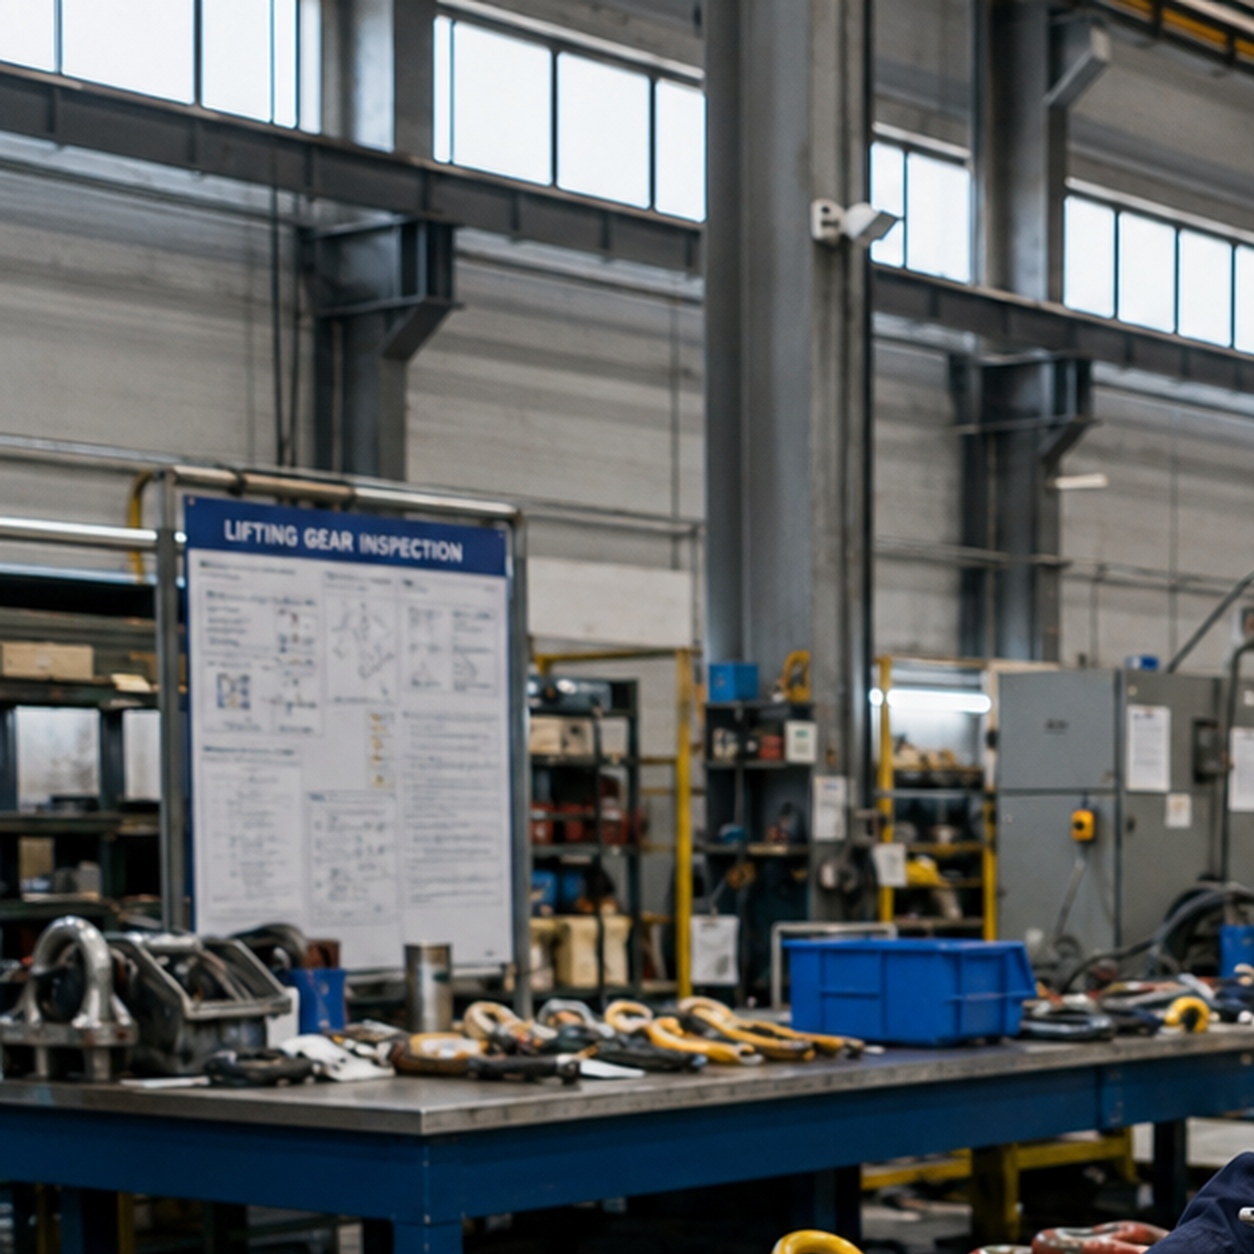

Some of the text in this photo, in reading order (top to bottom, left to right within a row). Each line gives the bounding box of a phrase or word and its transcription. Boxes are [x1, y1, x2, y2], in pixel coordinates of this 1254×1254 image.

[224, 519, 463, 563] LIFTING GEAR INSPECTION
